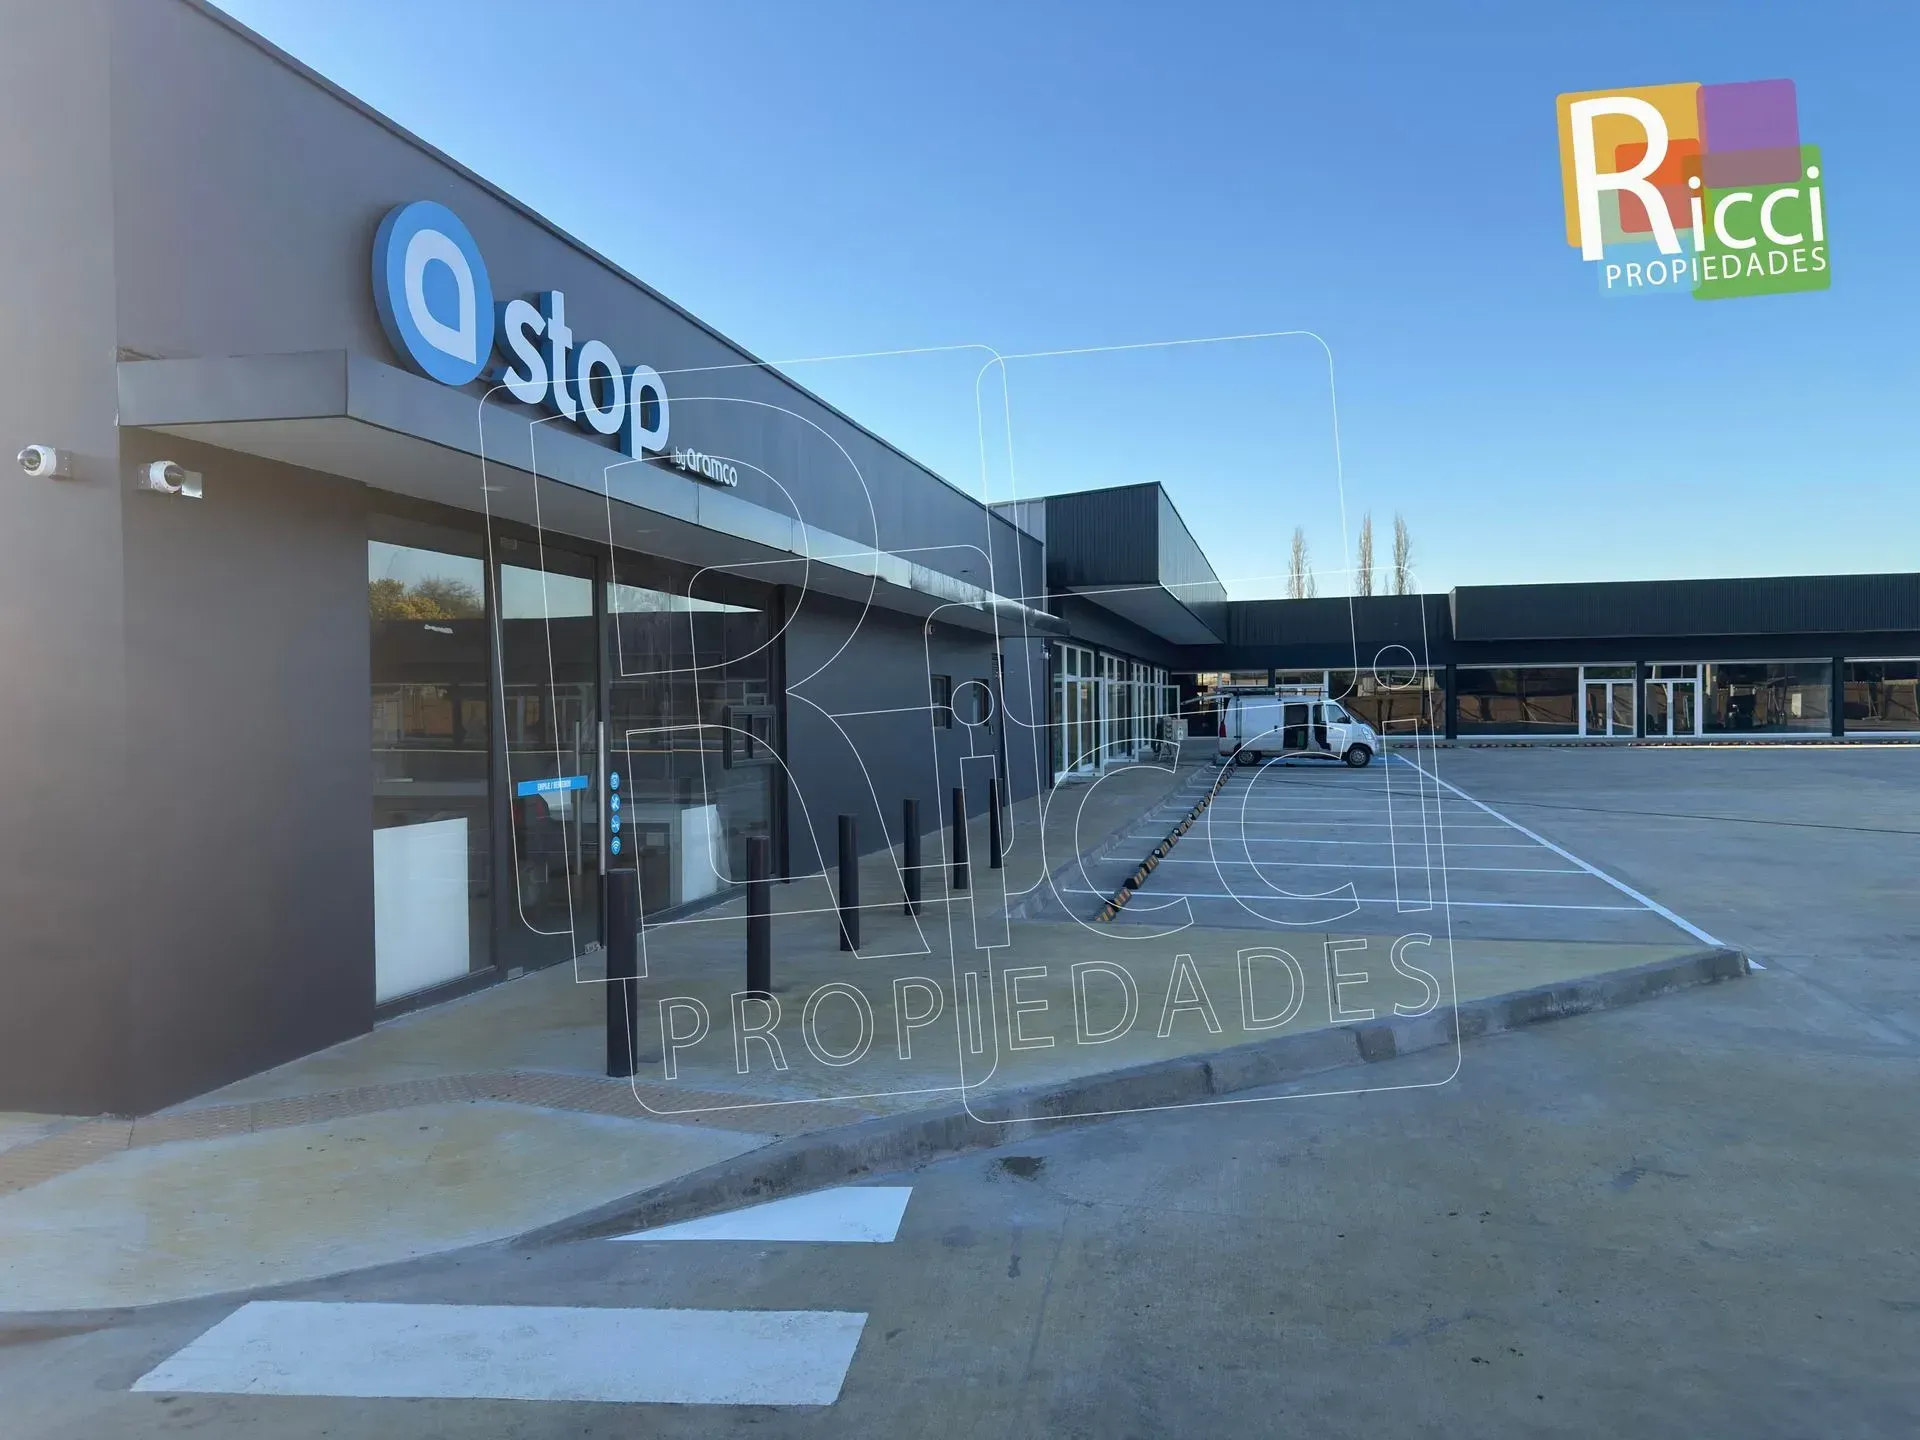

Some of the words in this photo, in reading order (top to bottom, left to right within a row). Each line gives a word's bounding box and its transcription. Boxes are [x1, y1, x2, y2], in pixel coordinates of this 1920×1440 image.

[501, 290, 670, 461] stop
[675, 446, 686, 471] by
[687, 448, 738, 488] aramco
